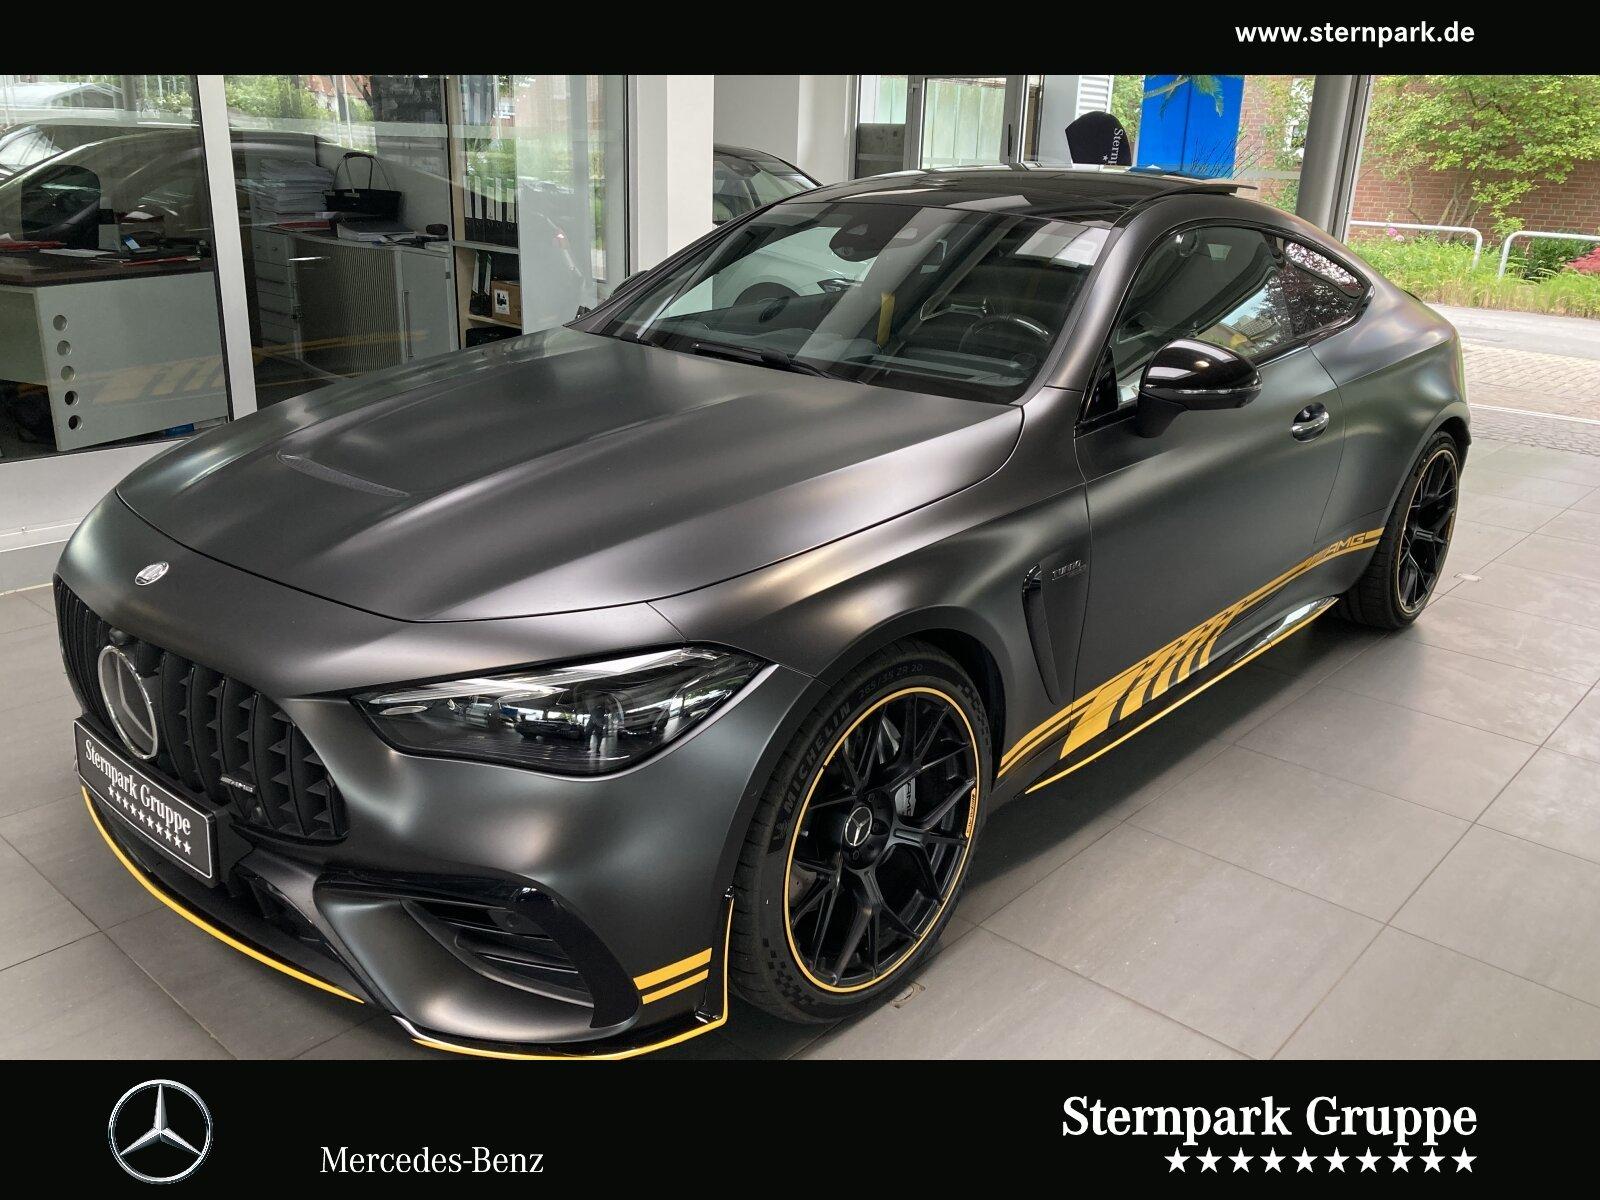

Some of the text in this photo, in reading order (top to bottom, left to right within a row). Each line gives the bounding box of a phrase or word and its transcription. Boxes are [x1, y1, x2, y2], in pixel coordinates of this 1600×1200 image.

[1108, 128, 1124, 164] Stern
[1327, 532, 1366, 553] AMG
[85, 739, 191, 836] Sternpark Gruppe
[783, 702, 852, 815] MICHELIN
